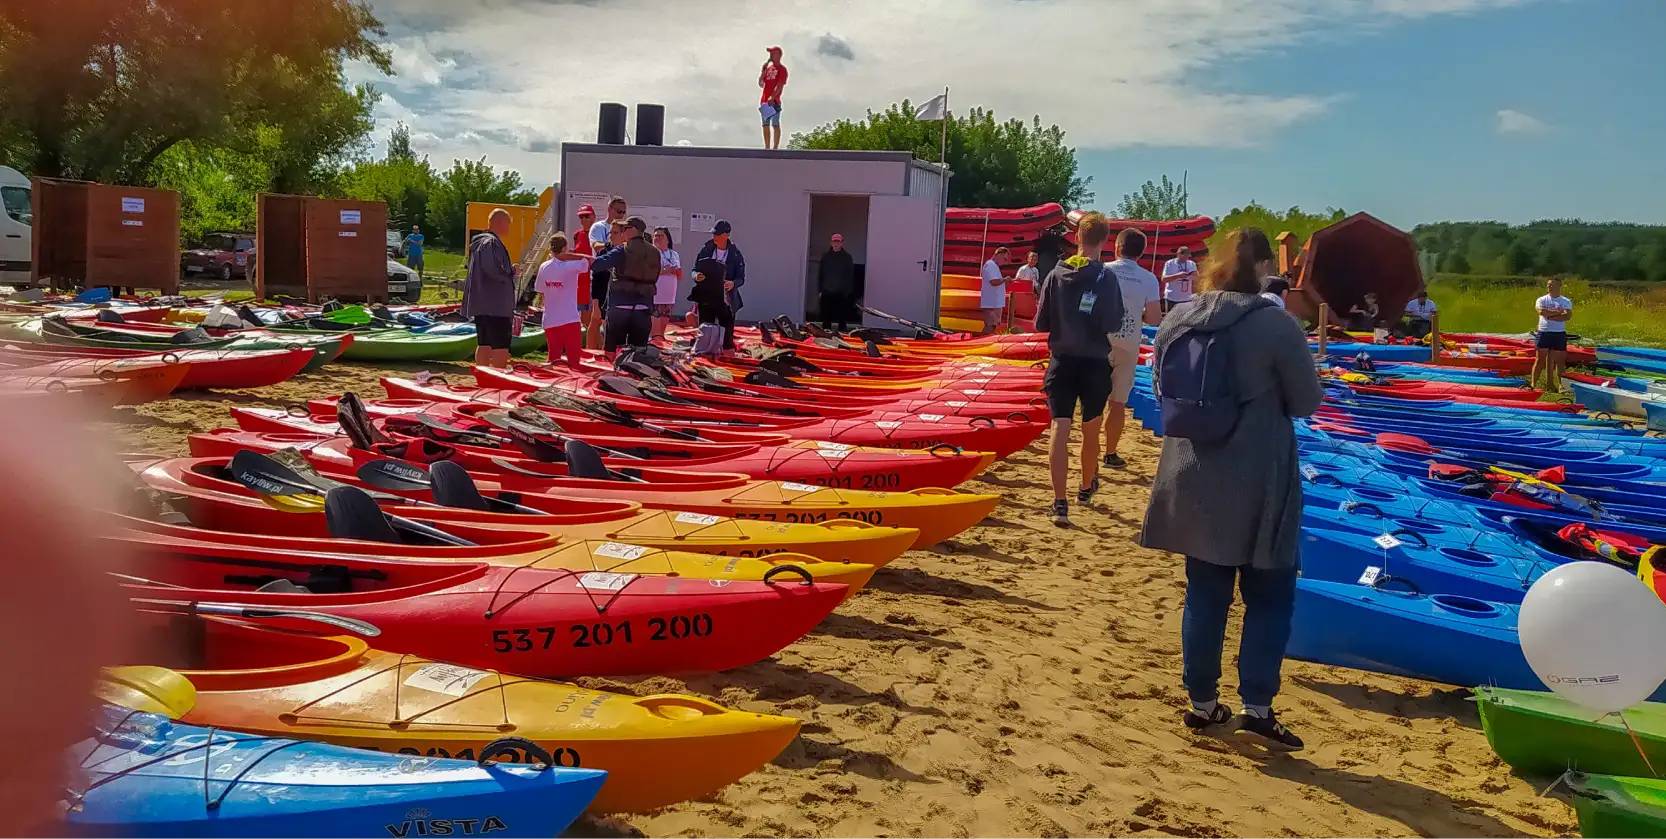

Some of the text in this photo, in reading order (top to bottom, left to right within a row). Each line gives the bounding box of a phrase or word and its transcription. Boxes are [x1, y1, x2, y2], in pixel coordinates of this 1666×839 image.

[862, 472, 900, 489] 200
[492, 613, 714, 653] 537 201 200
[385, 815, 508, 838] VISTA
